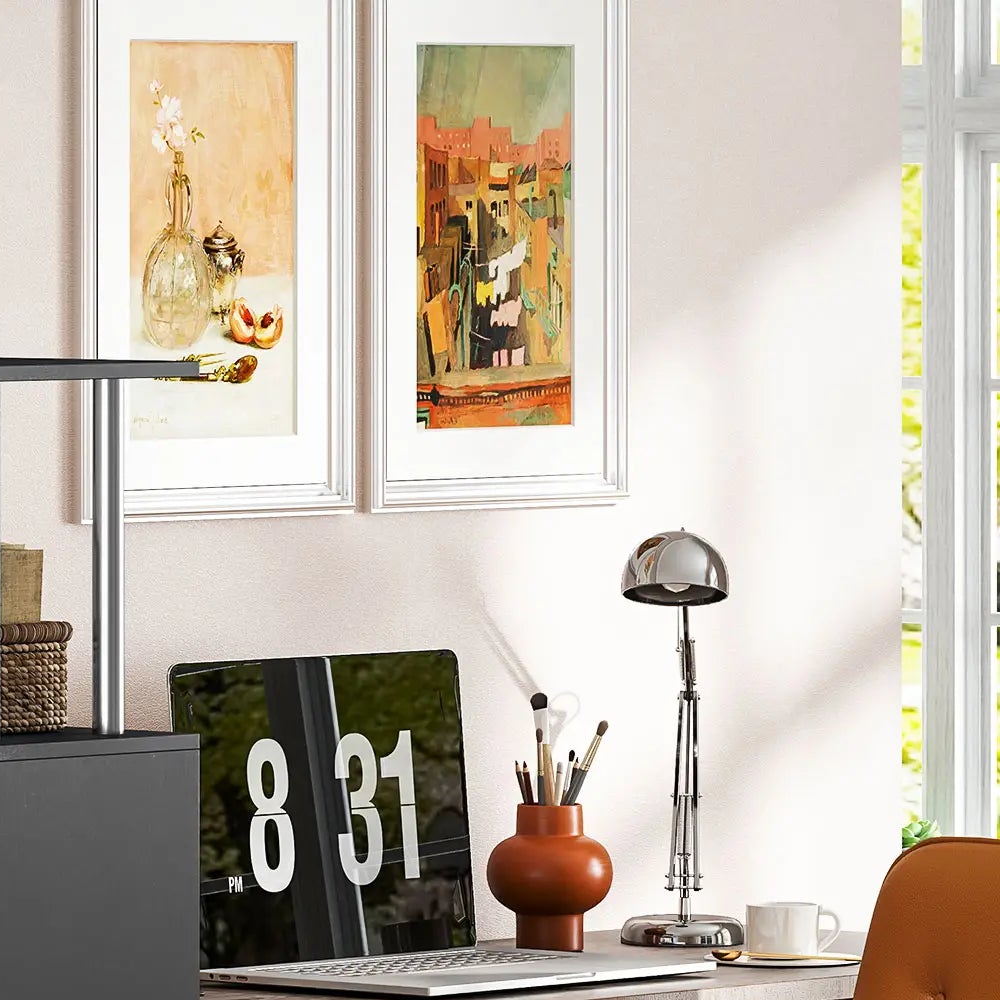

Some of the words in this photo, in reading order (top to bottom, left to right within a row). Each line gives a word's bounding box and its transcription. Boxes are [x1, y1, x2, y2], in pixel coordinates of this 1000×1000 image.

[246, 738, 296, 893] 8
[335, 730, 420, 886] 31
[228, 876, 243, 893] PM
